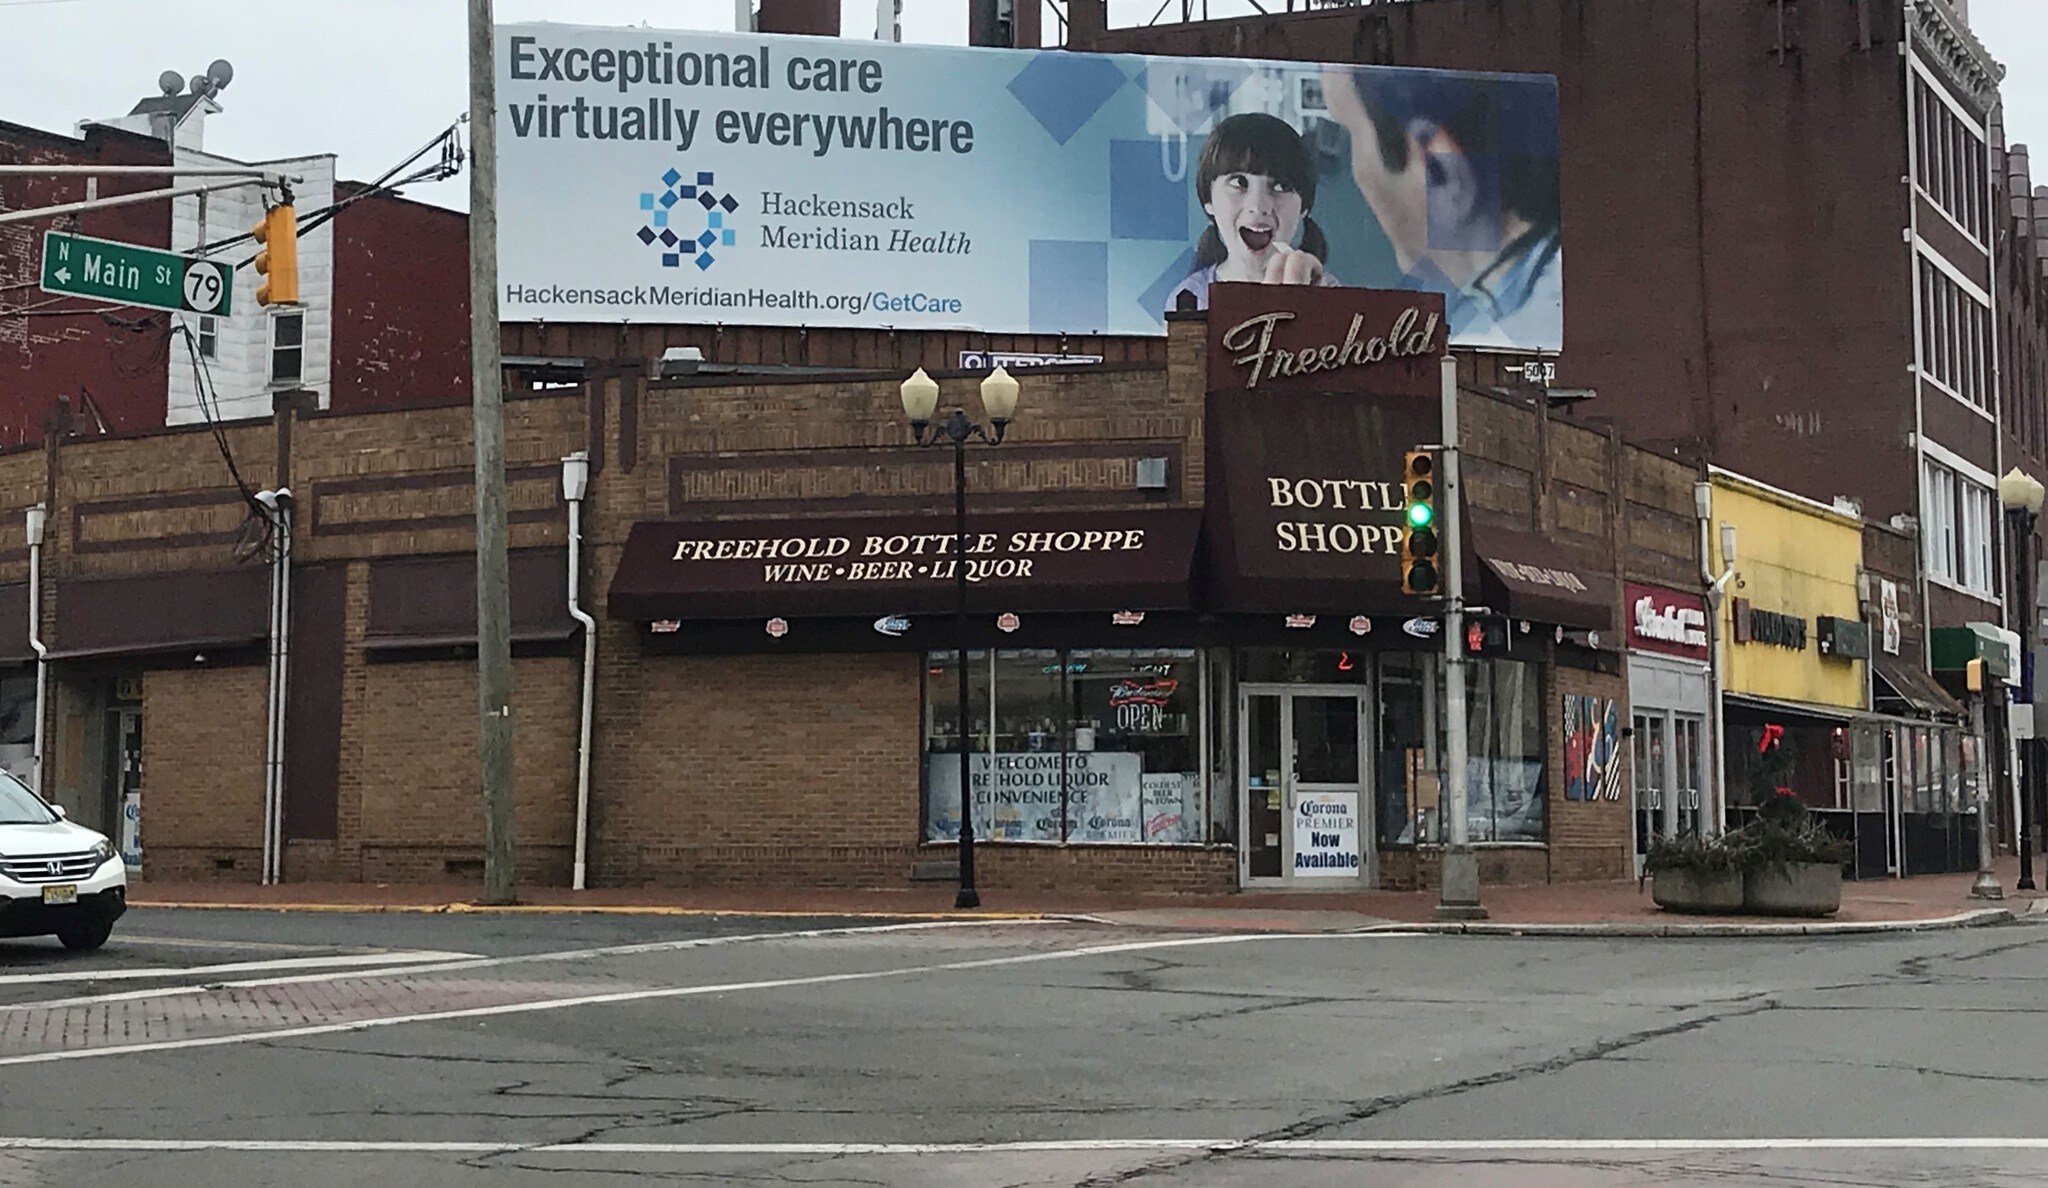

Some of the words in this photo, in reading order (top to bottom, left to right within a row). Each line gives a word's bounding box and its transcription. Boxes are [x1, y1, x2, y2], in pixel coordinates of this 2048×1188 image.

[510, 36, 769, 93] Exceptional
[787, 55, 882, 94] care
[509, 94, 700, 151] virtually
[715, 107, 974, 157] everywhere
[761, 192, 915, 220] Hackensack
[760, 225, 880, 251] Meridian
[886, 229, 972, 254] Health
[59, 241, 70, 261] N
[84, 253, 139, 290] Main
[155, 264, 172, 286] St
[189, 273, 220, 302] 79
[506, 284, 962, 315] HackensackMeridianHealth.org/GetCare
[1223, 305, 1440, 389] Freehold
[1267, 478, 1408, 511] BOTTL
[673, 537, 850, 561] FREEHOLD
[1008, 530, 1145, 552] SHOPPE
[1276, 522, 1404, 554] SHOPP
[1117, 705, 1163, 730] OPEN
[982, 756, 1061, 770] WELCOME
[1066, 755, 1088, 770] TO
[971, 773, 1044, 786] REHOLD
[1048, 772, 1109, 789] LIQUOR
[976, 790, 1088, 804] CONVENIENCE
[1300, 800, 1348, 817] Corona
[1036, 817, 1078, 831] Corna
[1296, 817, 1354, 829] PREMIER
[1311, 831, 1340, 847] Now
[1295, 852, 1358, 868] Available
